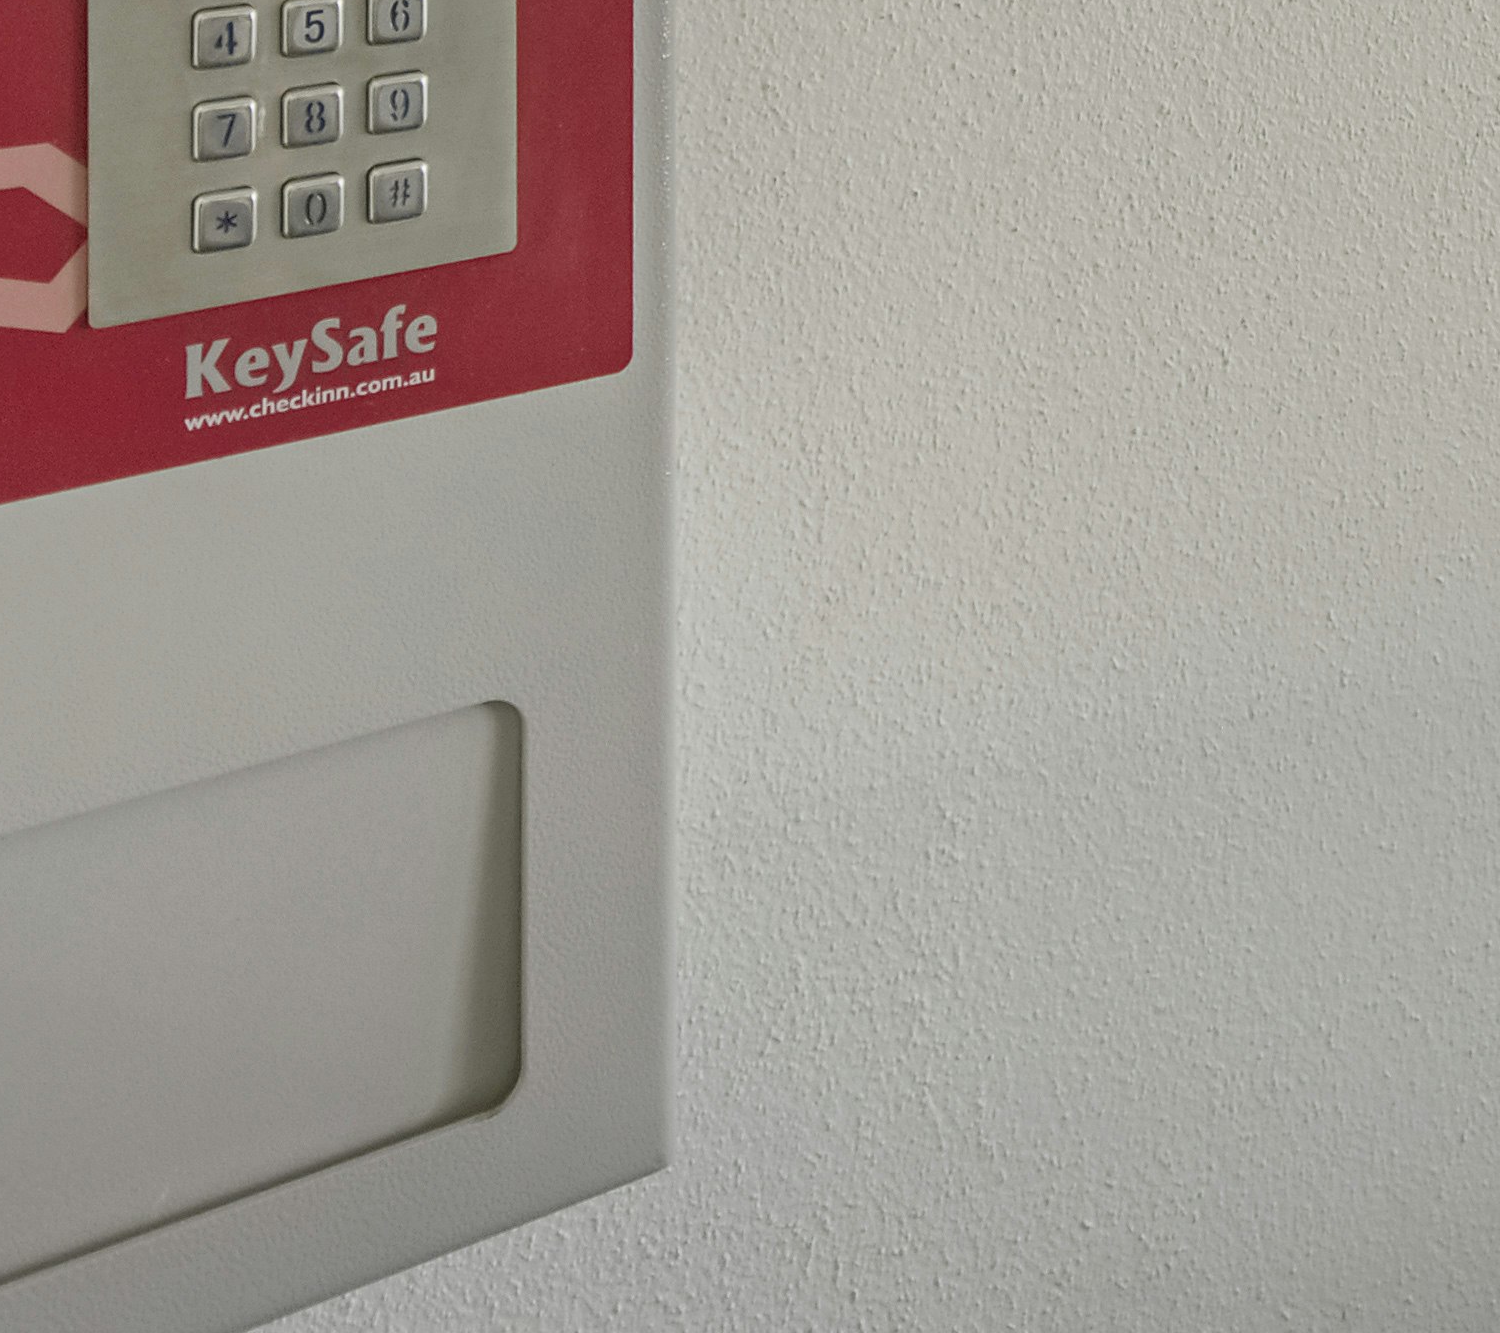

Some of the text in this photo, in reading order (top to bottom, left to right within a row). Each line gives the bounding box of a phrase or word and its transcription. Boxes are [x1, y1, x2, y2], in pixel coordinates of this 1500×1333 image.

[214, 20, 238, 55] 4
[304, 8, 325, 44] 5
[216, 87, 410, 148] 7 8 9
[304, 192, 326, 227] 0
[184, 303, 440, 400] KeySafe
[184, 367, 436, 432] www.checkinn.com.au
